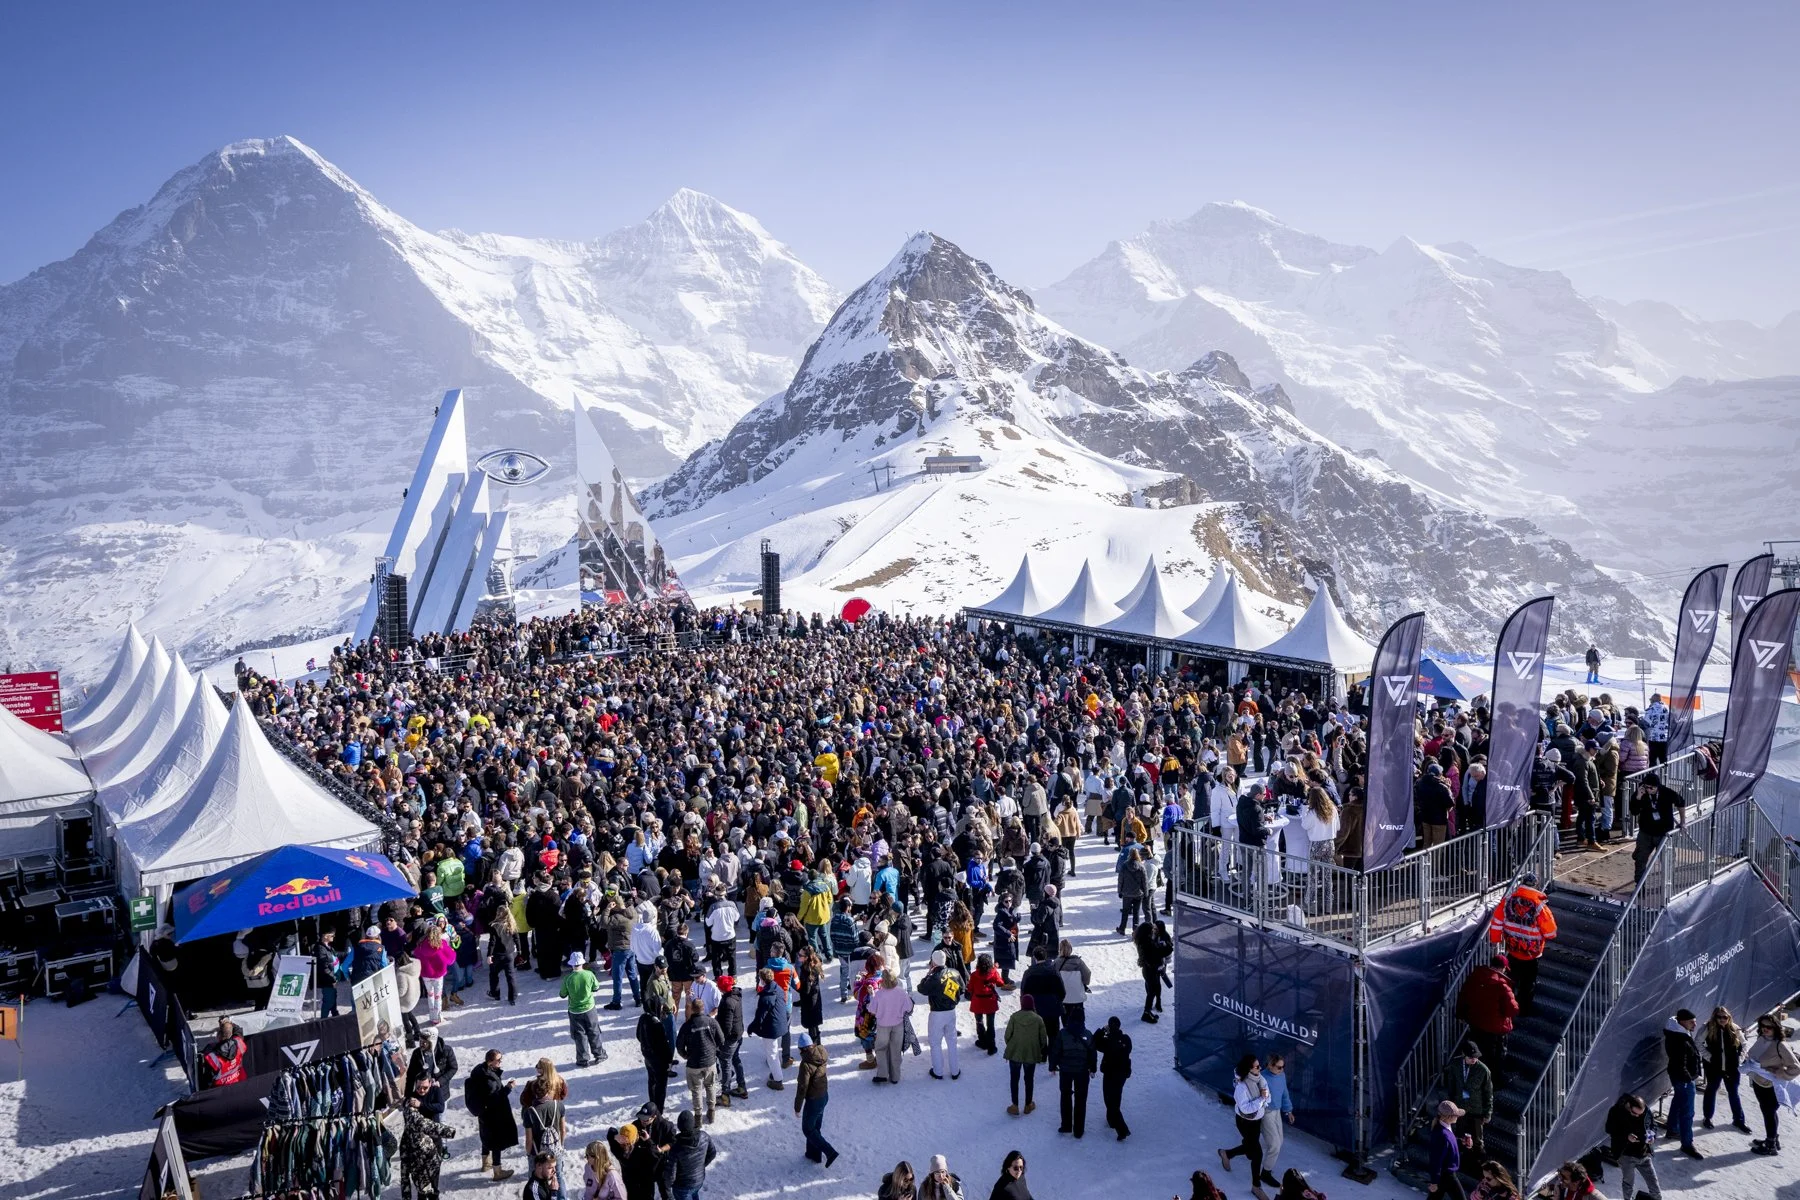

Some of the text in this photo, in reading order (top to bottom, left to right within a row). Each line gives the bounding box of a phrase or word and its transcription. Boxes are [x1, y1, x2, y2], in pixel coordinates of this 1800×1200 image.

[258, 888, 342, 916] Red Bull
[1675, 952, 1709, 980] As you rise
[1689, 972, 1700, 986] the
[362, 983, 390, 1010] Watt
[1213, 993, 1309, 1038] GRINDELWALD
